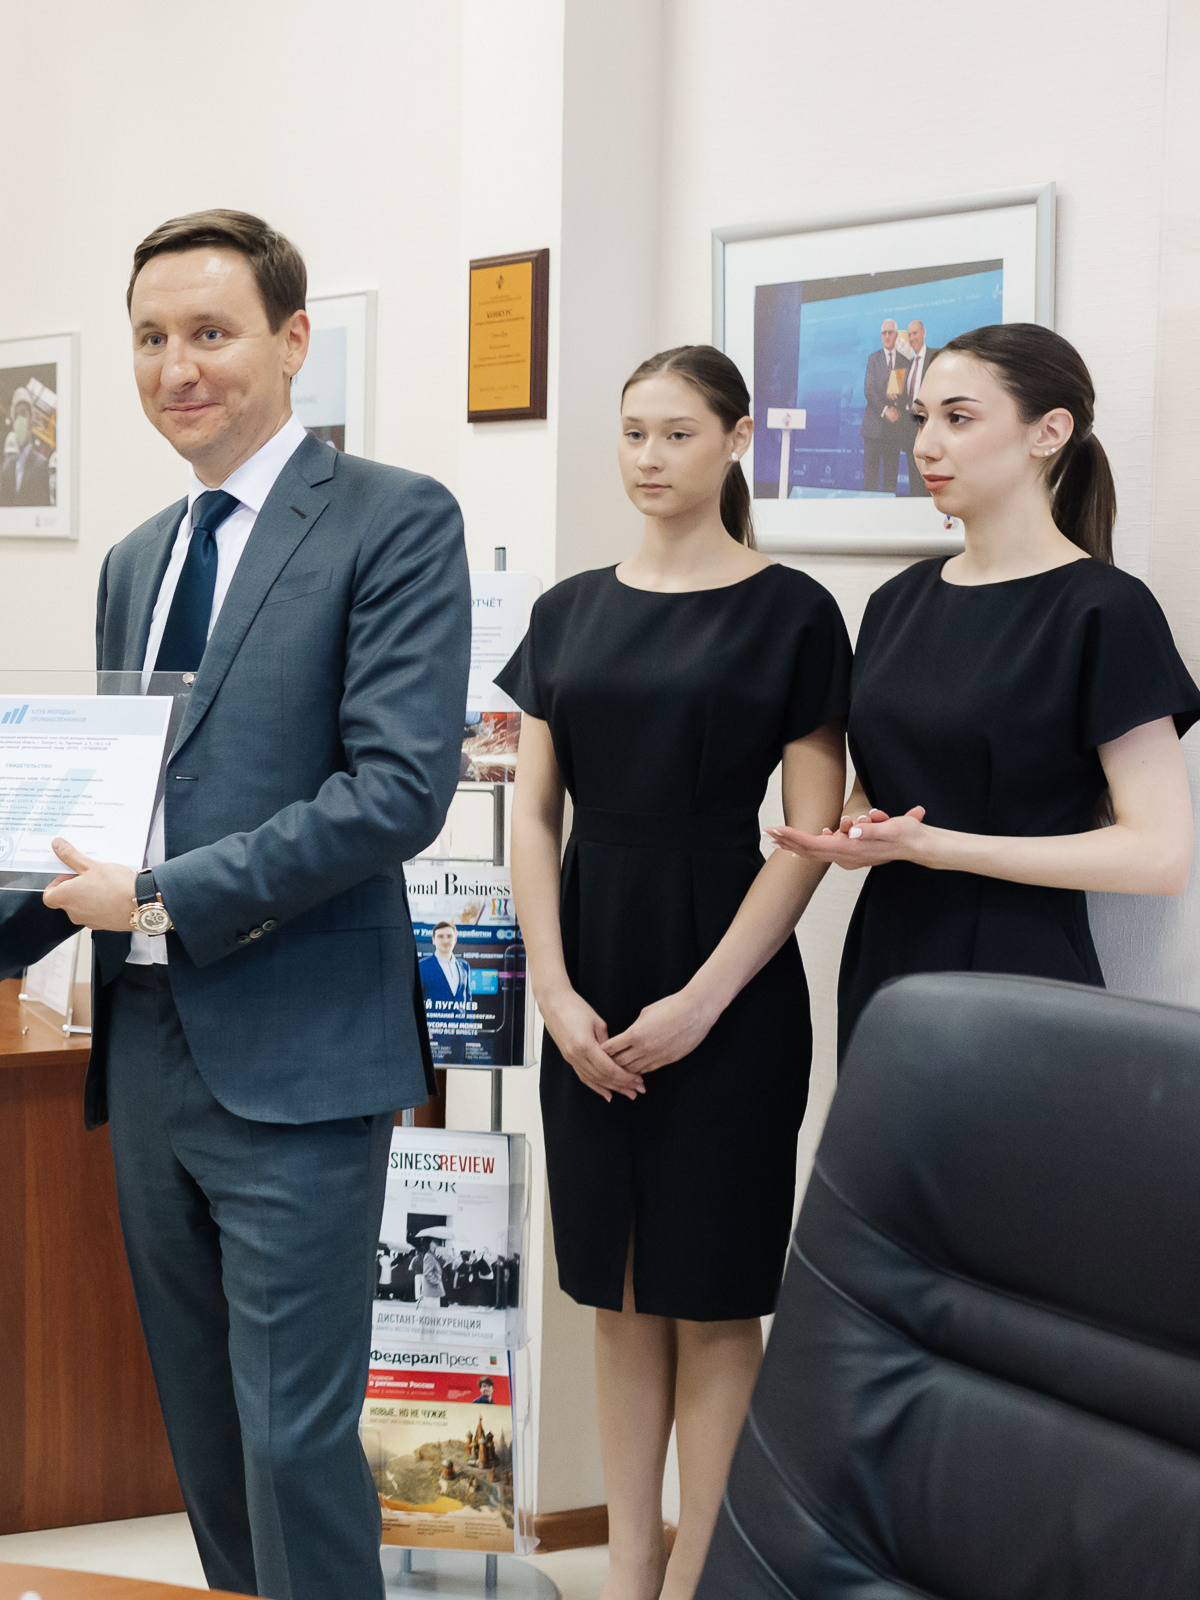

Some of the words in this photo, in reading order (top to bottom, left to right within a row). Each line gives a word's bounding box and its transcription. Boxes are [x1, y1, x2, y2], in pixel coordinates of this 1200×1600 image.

[405, 880, 438, 895] onal
[443, 873, 511, 896] Business
[435, 1001, 478, 1011] ПУГАЧЕВ
[390, 1152, 495, 1174] SINESSREVIEW
[377, 1312, 482, 1329] ДИСТАНТ-КОНКУРЕНЦИЯ
[370, 1350, 480, 1368] ФедералПресс
